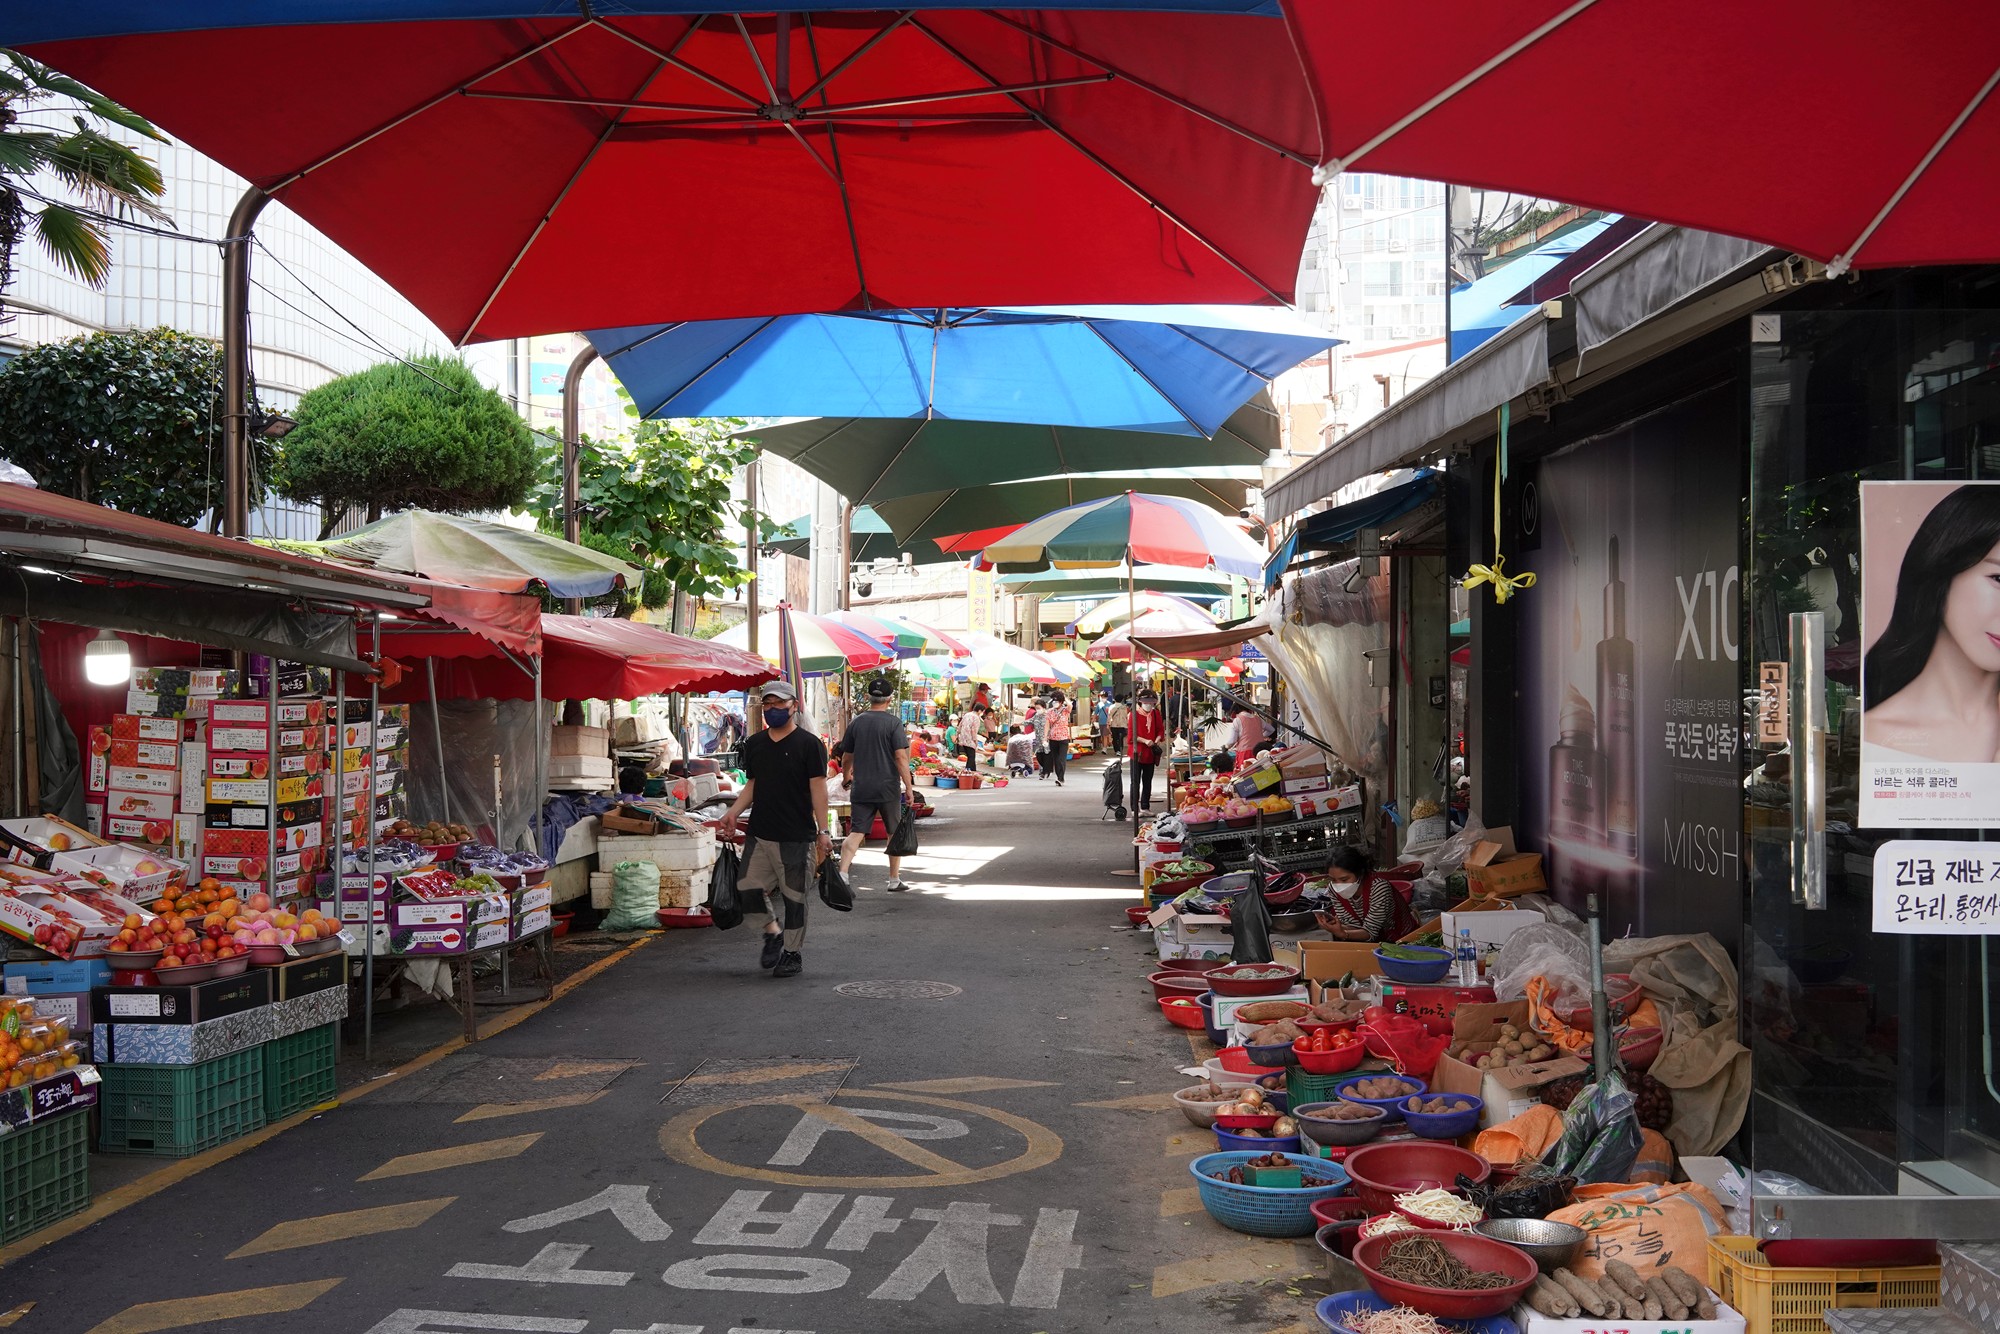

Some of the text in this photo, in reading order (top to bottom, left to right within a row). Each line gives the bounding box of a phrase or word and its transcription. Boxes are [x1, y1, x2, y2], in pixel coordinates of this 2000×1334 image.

[1664, 698, 1671, 715] 더
[1671, 697, 1696, 717] 강력해진
[1697, 698, 1716, 718] 보랏빛
[1717, 698, 1731, 718] 탄력
[1763, 664, 1783, 736] 고정문
[1664, 722, 1677, 757] 푹
[1678, 722, 1704, 760] 잔듯
[1572, 758, 1584, 772] TIME
[1874, 777, 1958, 788] 바르는 석류 콜라겐
[1664, 818, 1739, 880] MISSH
[1896, 858, 1935, 887] 긴급
[1945, 858, 1984, 883] 재난
[1894, 893, 2000, 922] 온누리.통영사
[1408, 1003, 1447, 1020] 토마토
[444, 1183, 1084, 1310] 소방차
